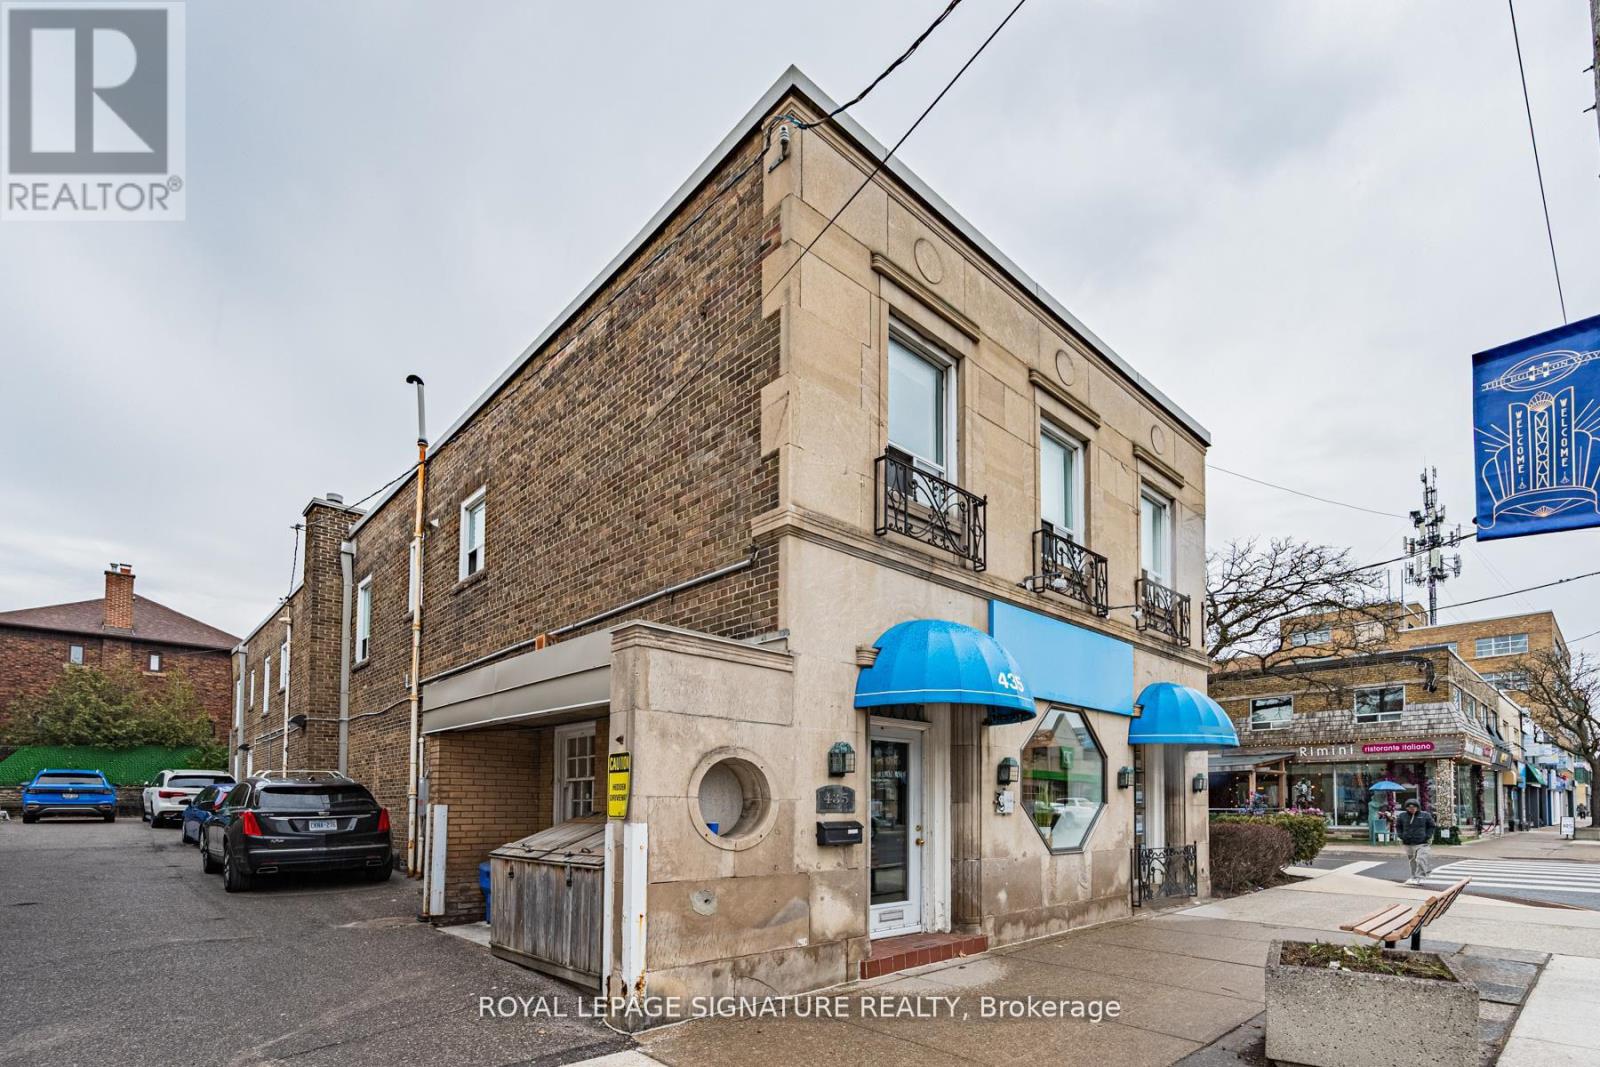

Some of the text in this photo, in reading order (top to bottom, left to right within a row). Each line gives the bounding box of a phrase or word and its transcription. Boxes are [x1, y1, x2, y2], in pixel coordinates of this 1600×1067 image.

[1515, 410, 1525, 474] WELCOME
[1560, 398, 1569, 467] WELCOME
[998, 672, 1024, 692] 435
[1299, 743, 1431, 757] Rimini ristorante italiano
[823, 792, 849, 805] 435
